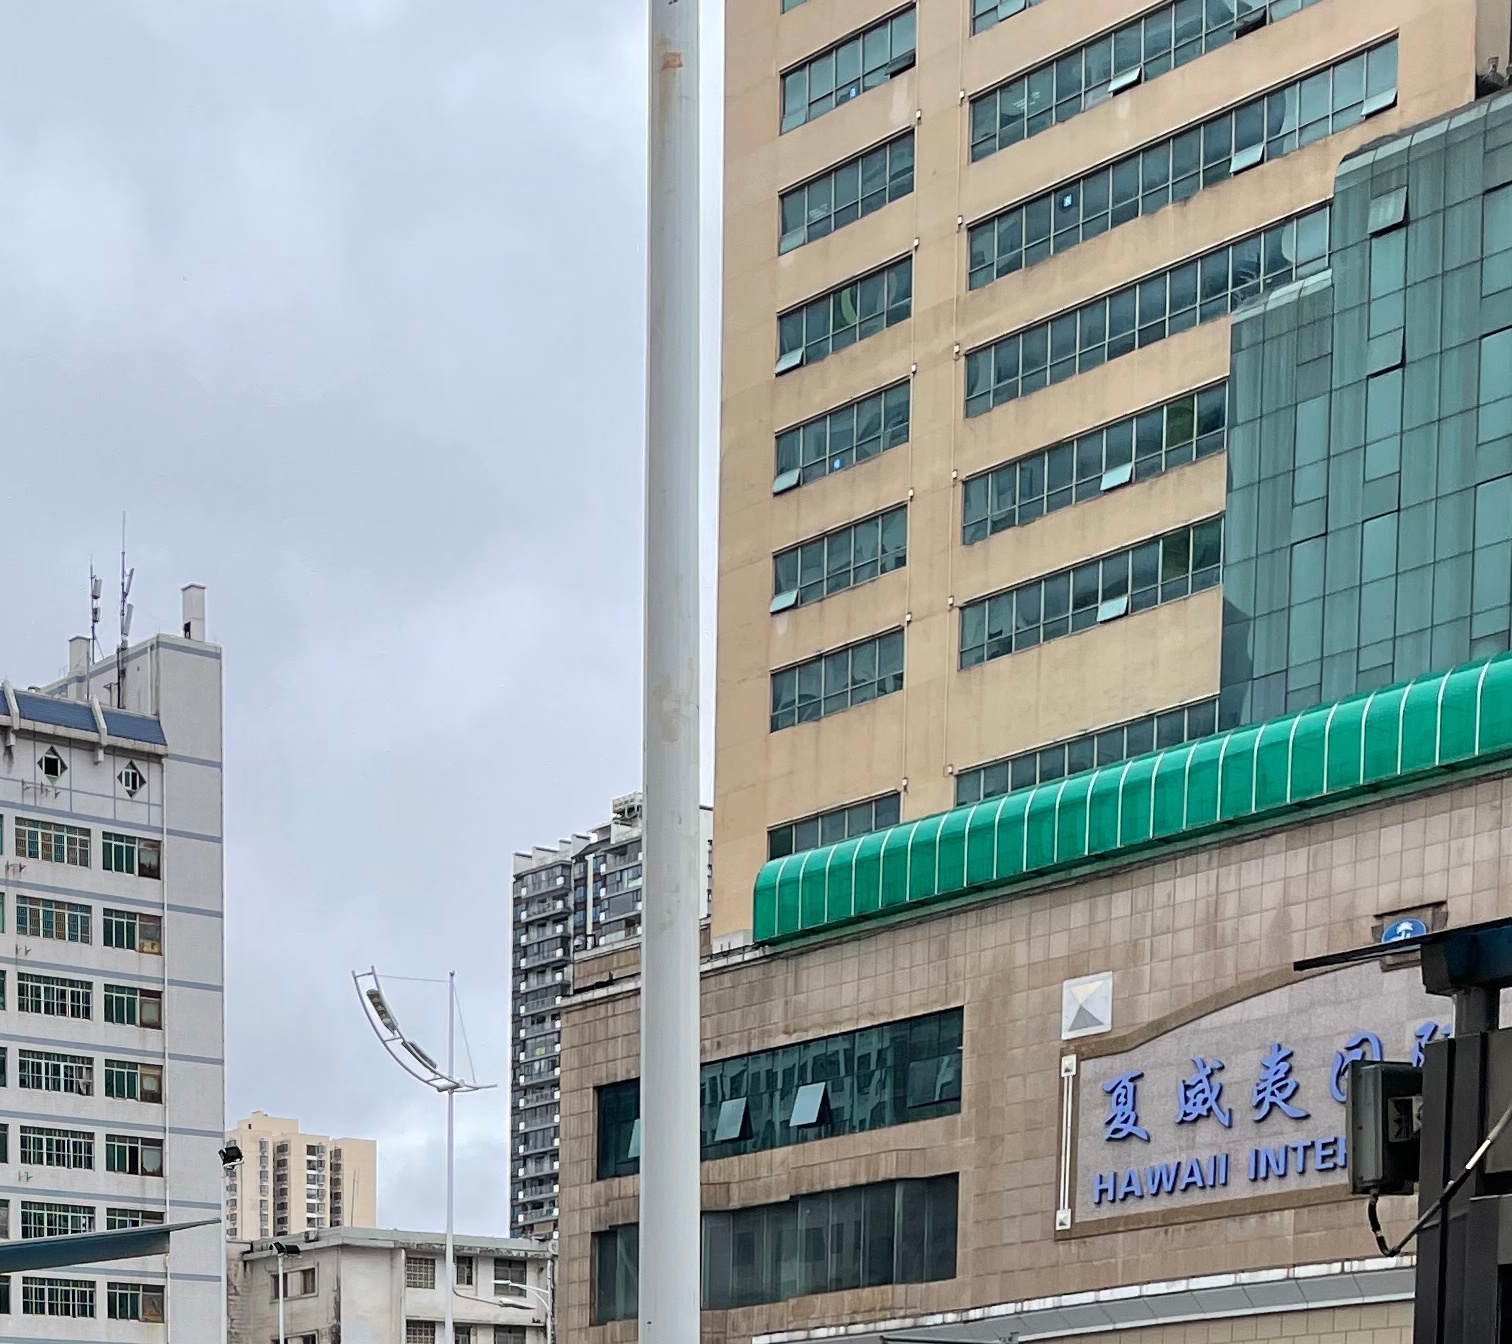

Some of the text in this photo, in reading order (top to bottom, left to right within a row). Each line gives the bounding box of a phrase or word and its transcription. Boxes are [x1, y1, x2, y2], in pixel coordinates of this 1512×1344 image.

[1101, 1020, 1452, 1143] 夏威夷
[1093, 1153, 1228, 1205] HAWAII
